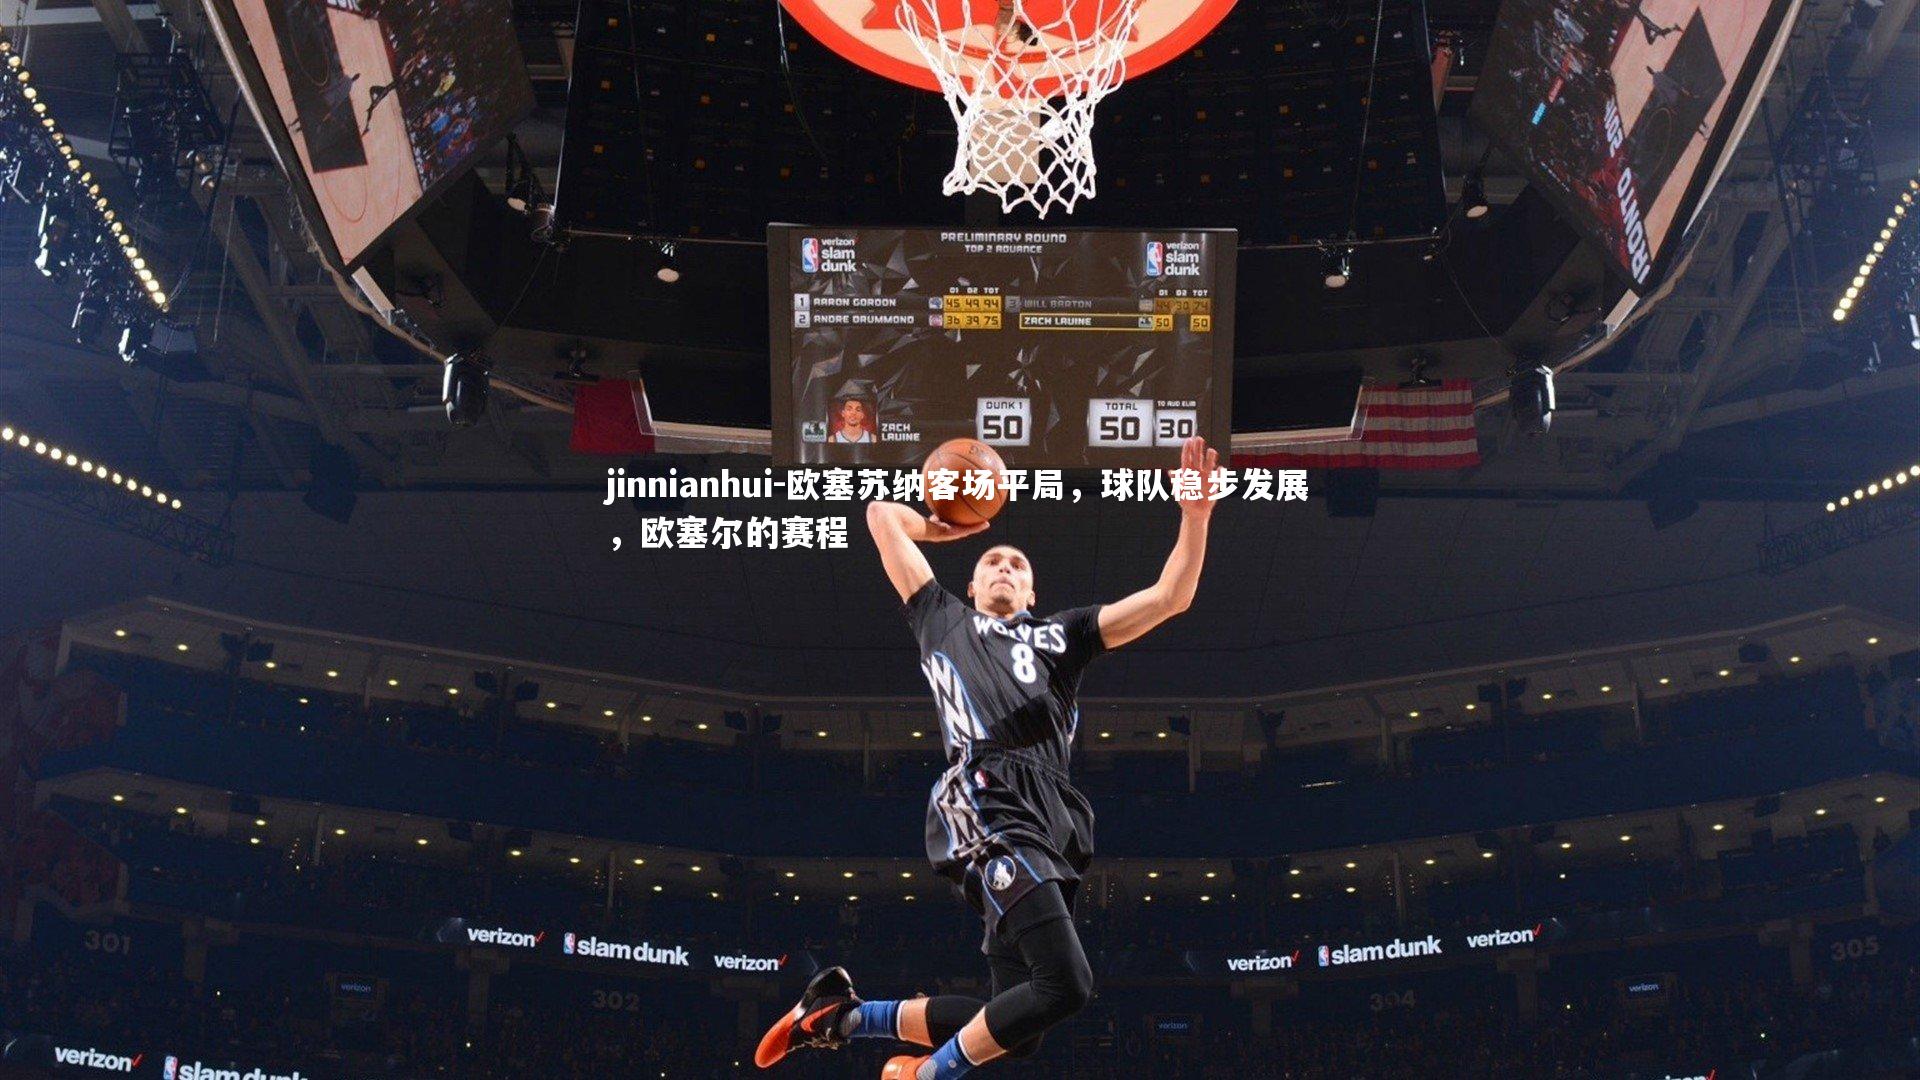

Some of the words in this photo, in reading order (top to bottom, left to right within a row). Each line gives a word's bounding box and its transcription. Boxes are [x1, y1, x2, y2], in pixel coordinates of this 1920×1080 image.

[821, 237, 855, 246] verizon
[940, 232, 1022, 242] PRELIMINARY
[1024, 233, 1067, 243] ROUND
[964, 244, 984, 253] TOP
[986, 244, 993, 253] 2
[1165, 241, 1200, 250] verizon
[821, 246, 856, 259] slam
[1165, 250, 1200, 263] slam
[821, 259, 857, 272] dunk
[1164, 263, 1200, 276] dunk
[813, 298, 850, 307] AARON
[853, 298, 897, 307] GORDON
[946, 299, 961, 308] 45
[965, 299, 980, 308] 49
[983, 299, 1000, 308] 94
[799, 314, 806, 324] 2
[813, 315, 850, 324] ANDRE
[852, 315, 915, 324] DRUMMOND
[965, 315, 980, 325] 39
[984, 315, 999, 325] 75
[1024, 317, 1052, 325] ZACH
[1156, 317, 1170, 327] 50
[1193, 318, 1208, 327] 50
[986, 401, 1015, 409] DUNK
[1105, 402, 1138, 411] TOTAL
[881, 422, 911, 431] ZACH
[983, 415, 1023, 439] 50
[1100, 416, 1140, 441] 50
[1160, 419, 1193, 439] 30
[1011, 642, 1038, 684] 8
[84, 930, 131, 955] 301
[467, 926, 536, 948] verizon
[1466, 926, 1534, 949] verizon
[577, 936, 631, 960] slam
[633, 942, 690, 967] dunk
[1331, 945, 1384, 966] slam
[1385, 935, 1442, 960] dunk
[1830, 935, 1879, 962] 305
[714, 952, 779, 972] verizon
[1227, 952, 1292, 972] verizon
[340, 982, 372, 993] verizon
[1628, 982, 1659, 993] verizon
[593, 990, 640, 1012] 302
[1158, 1020, 1188, 1030] verizon
[54, 1046, 132, 1072] verizon
